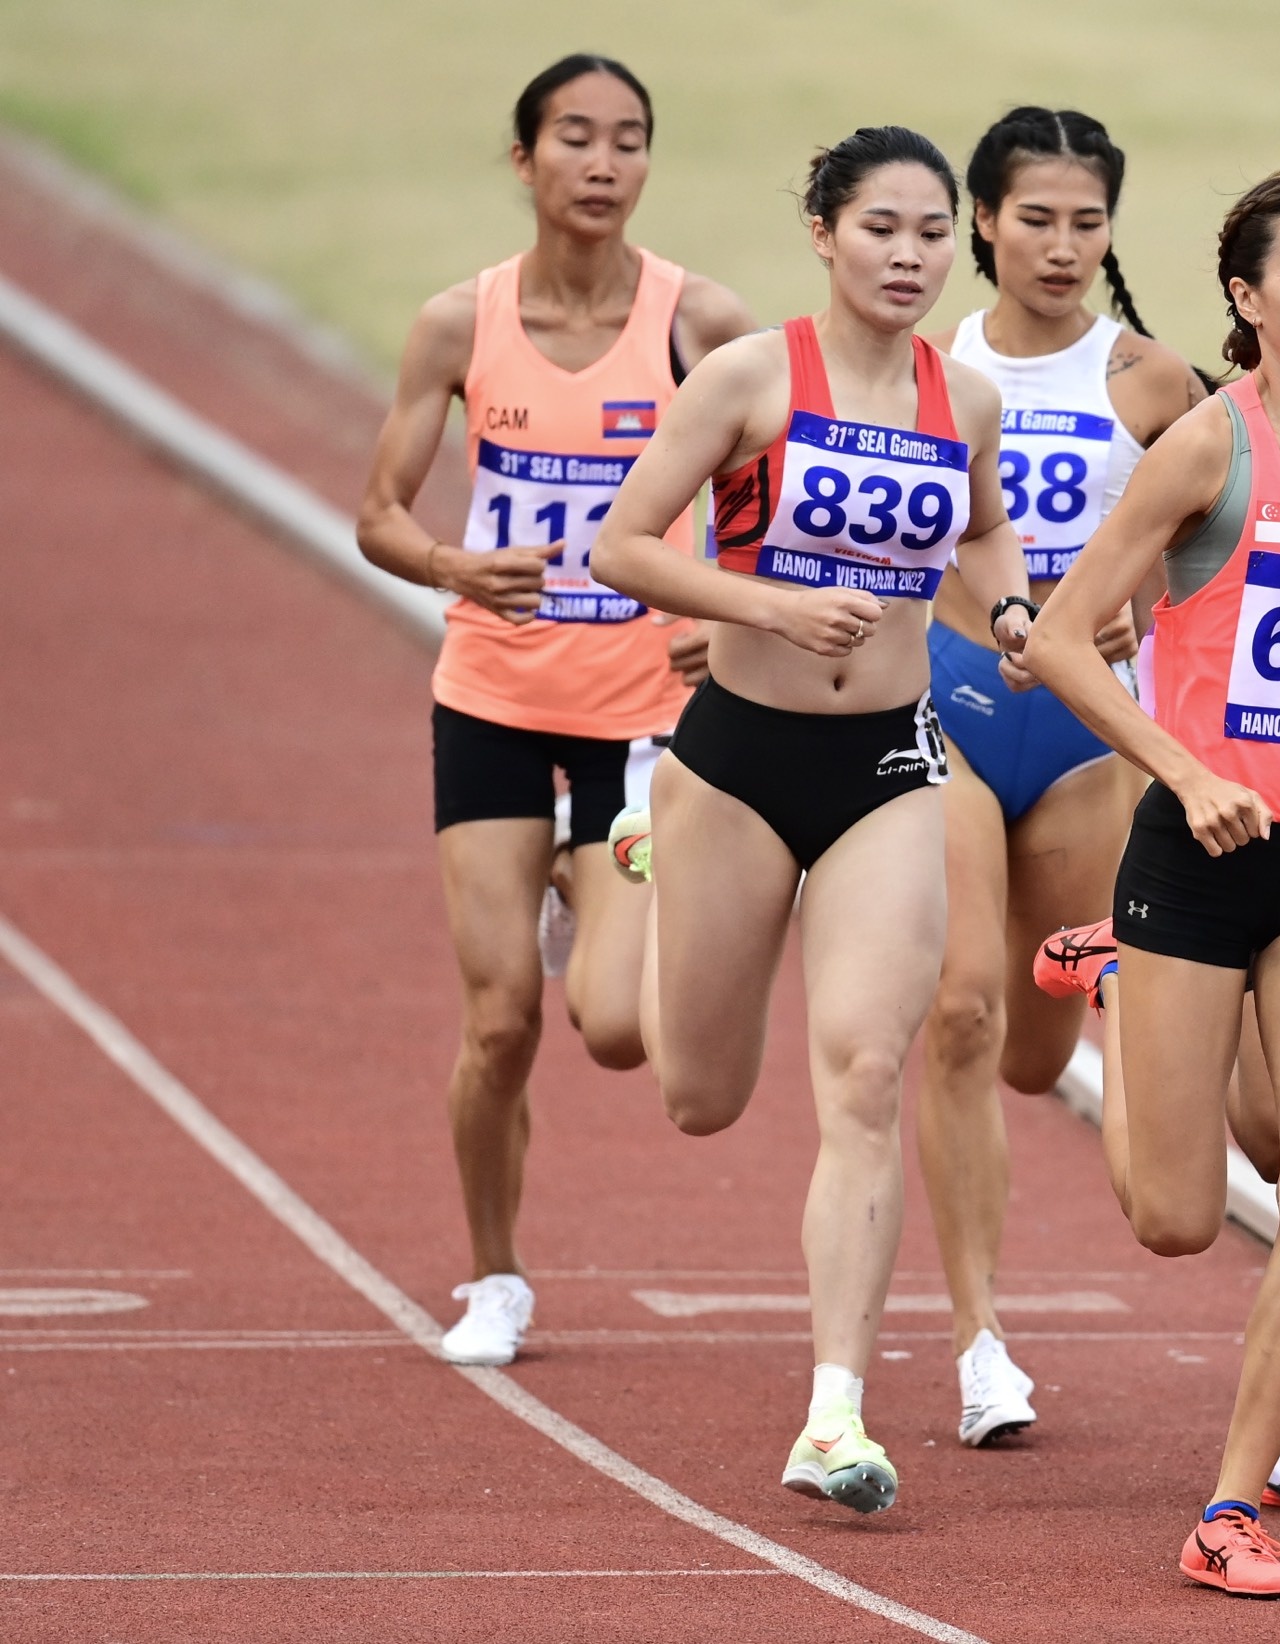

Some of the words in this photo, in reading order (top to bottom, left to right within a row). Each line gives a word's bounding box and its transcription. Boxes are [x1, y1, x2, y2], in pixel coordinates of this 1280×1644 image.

[487, 407, 529, 430] CAM
[1020, 411, 1078, 432] Games
[857, 428, 886, 454] SEA
[889, 433, 938, 462] Games
[529, 456, 563, 480] SEA
[566, 458, 624, 482] Games
[793, 465, 953, 550] 839
[833, 547, 893, 566] VIETNAM
[772, 550, 822, 582] HANOI
[836, 564, 896, 592] VIETNAM
[898, 572, 925, 593] 2022
